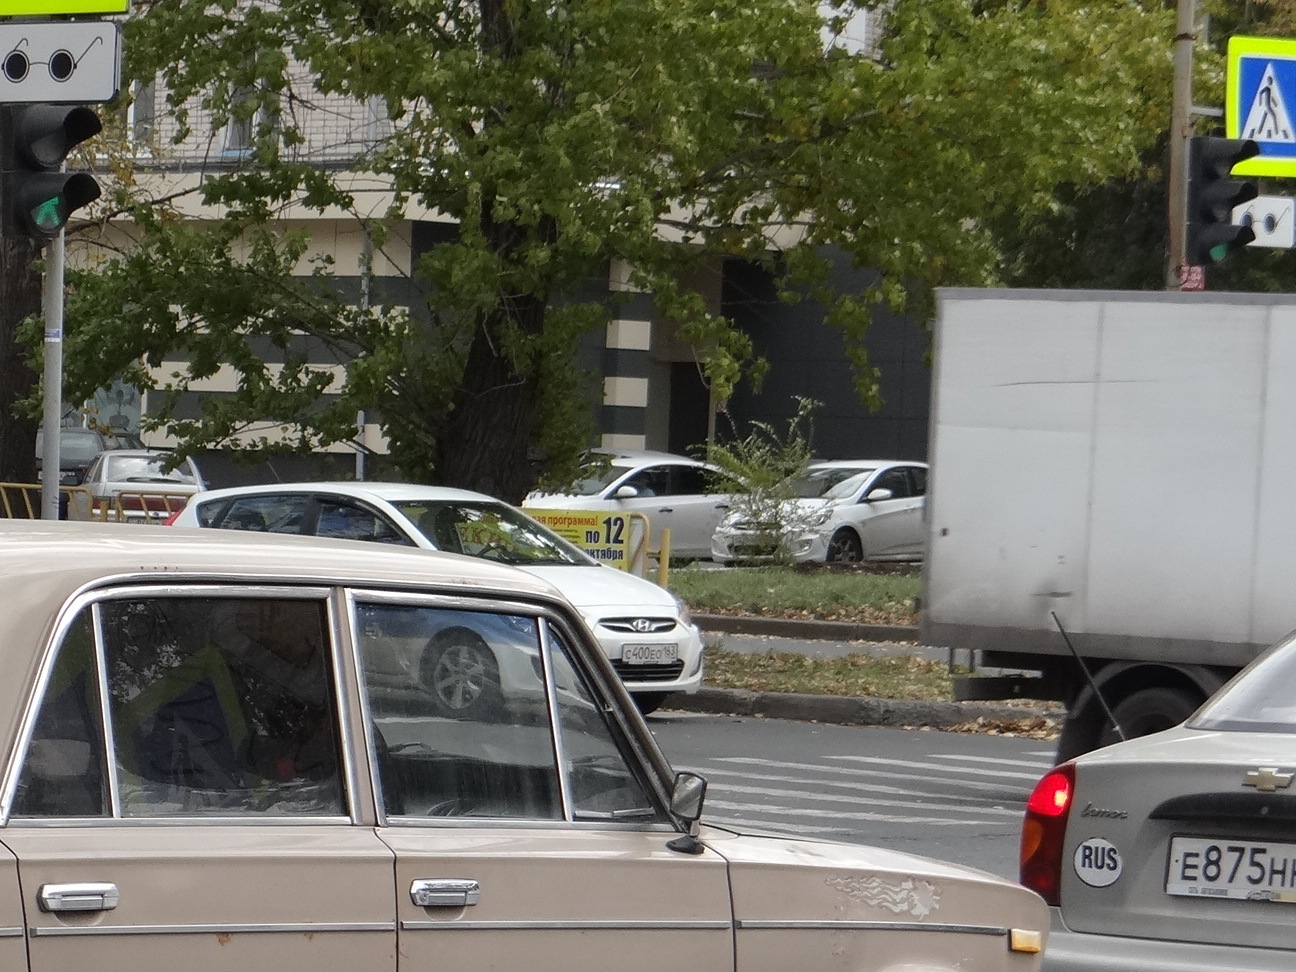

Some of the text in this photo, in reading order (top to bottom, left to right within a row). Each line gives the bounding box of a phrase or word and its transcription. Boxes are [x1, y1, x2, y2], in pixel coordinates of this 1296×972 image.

[547, 515, 598, 528] программа!
[585, 530, 600, 544] по
[602, 516, 625, 545] 12
[1080, 845, 1118, 871] RUS
